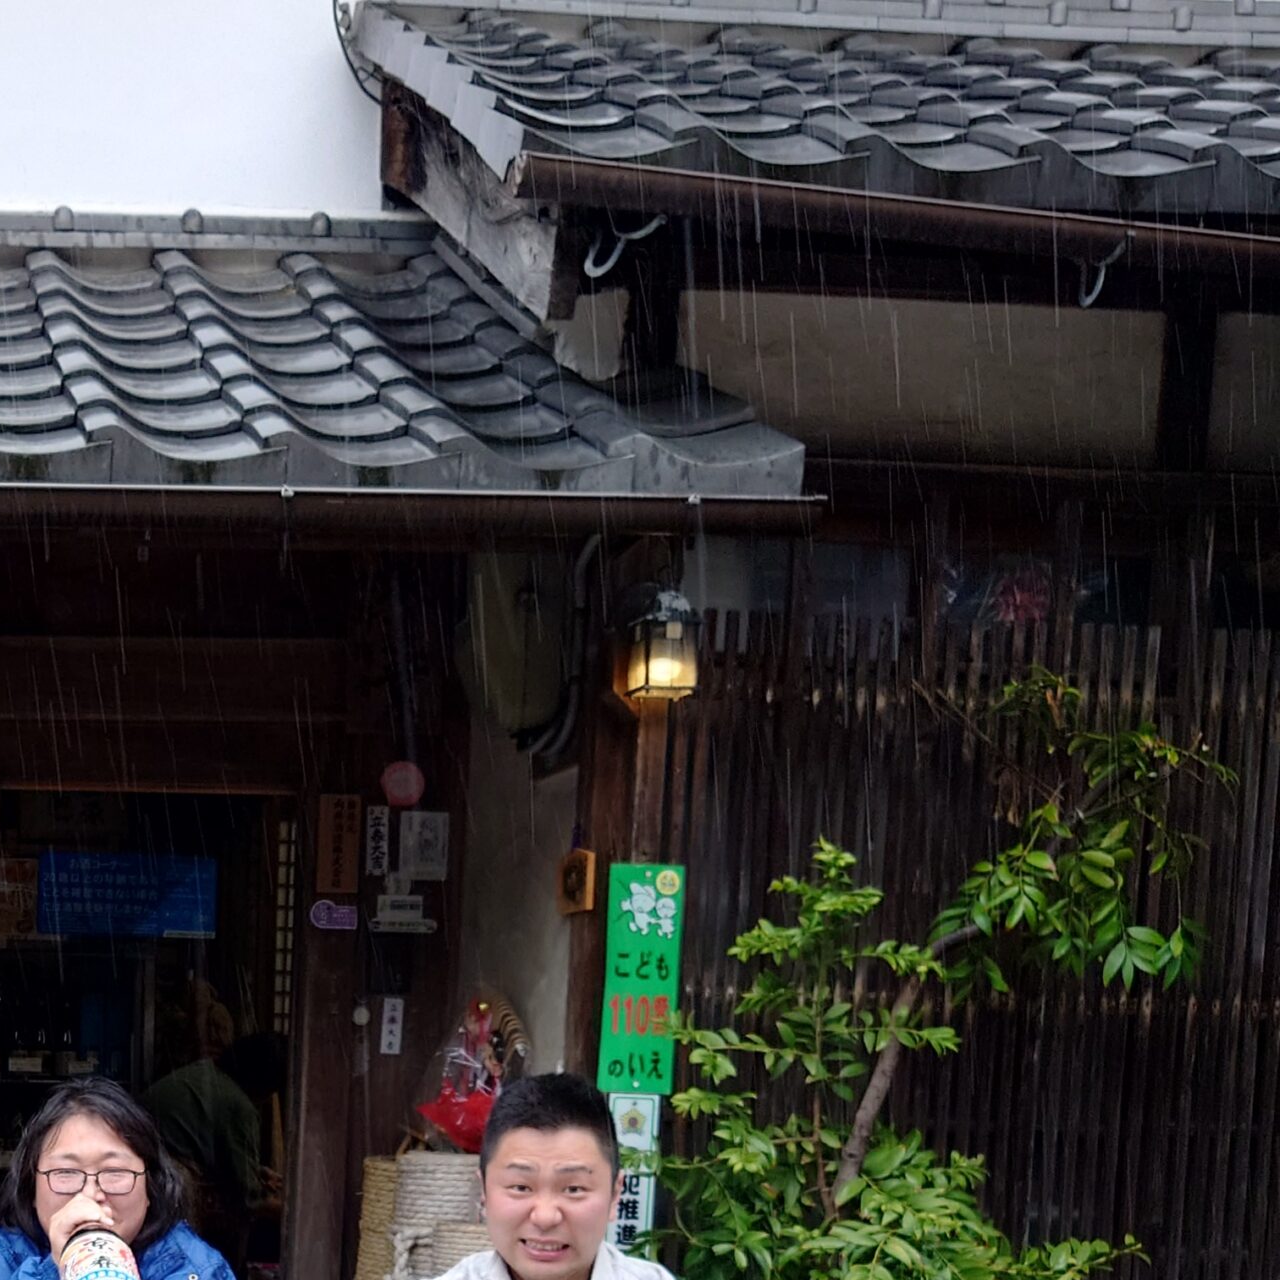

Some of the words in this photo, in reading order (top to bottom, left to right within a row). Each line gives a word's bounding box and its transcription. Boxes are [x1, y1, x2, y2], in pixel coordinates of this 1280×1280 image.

[615, 951, 669, 981] こども
[608, 1052, 664, 1079] のいえ
